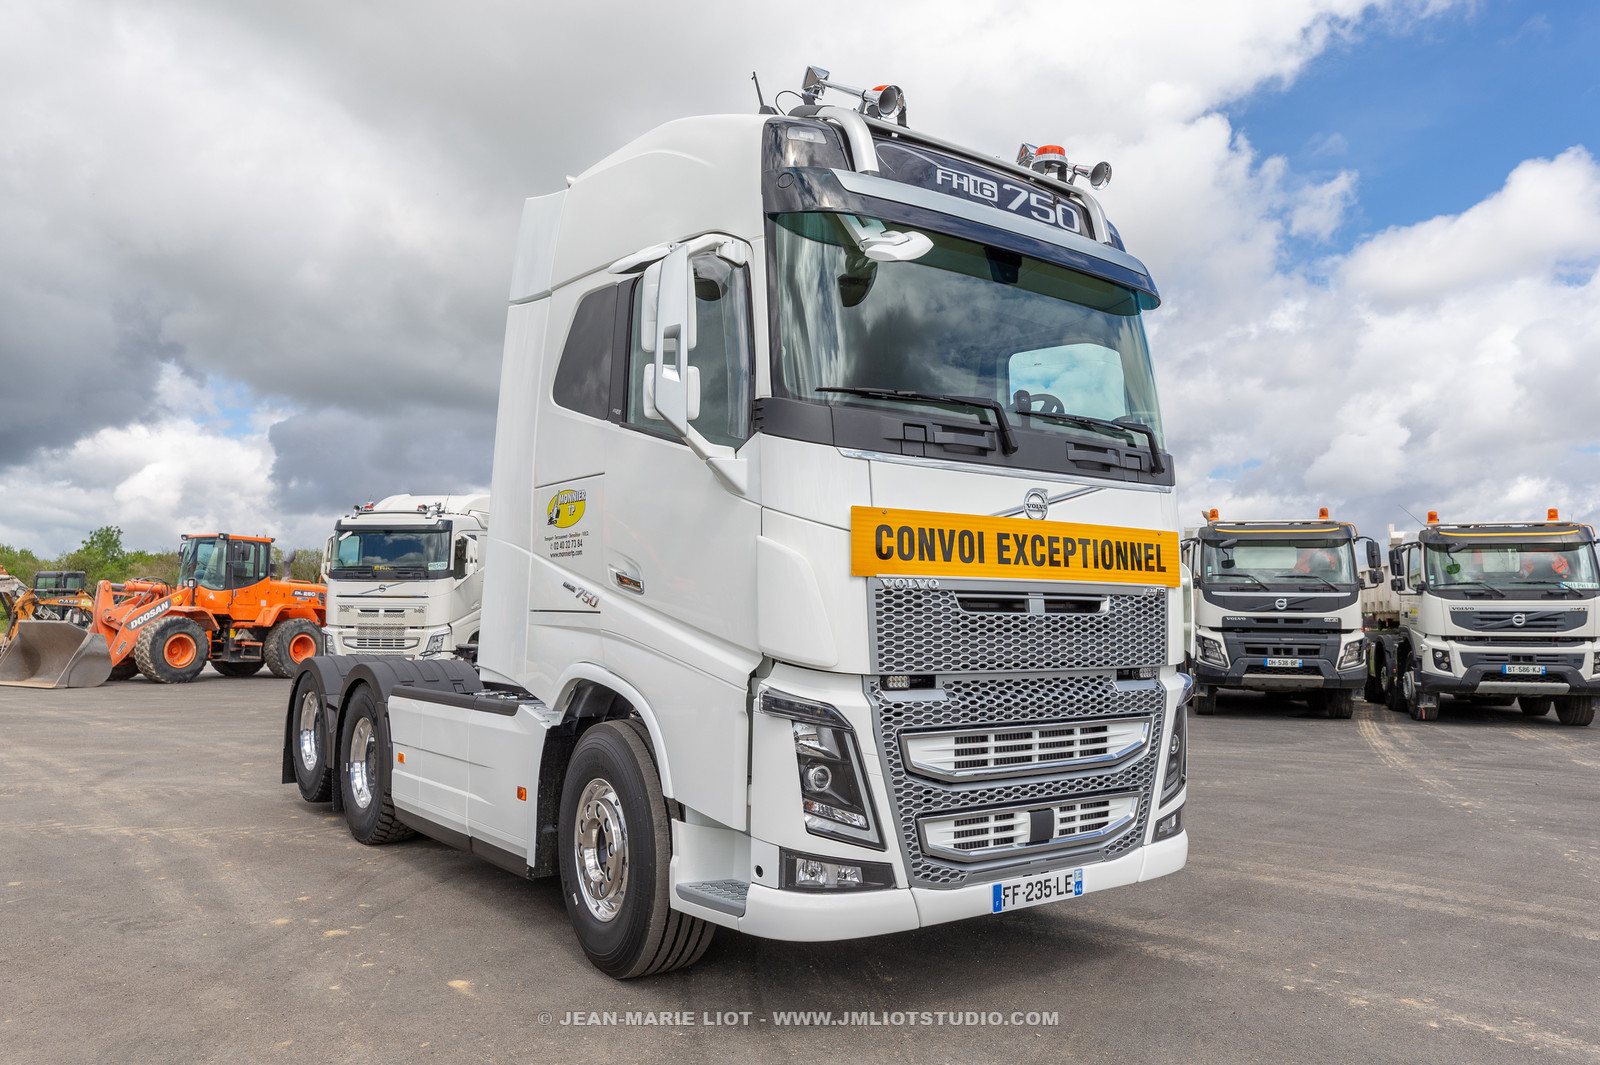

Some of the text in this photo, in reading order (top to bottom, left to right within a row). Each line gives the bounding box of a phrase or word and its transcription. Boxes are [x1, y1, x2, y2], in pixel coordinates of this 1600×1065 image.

[936, 168, 1081, 233] FH16 750
[559, 489, 587, 505] MONNIER
[875, 524, 1167, 573] CONVOI EXCEPTIONNEL
[880, 578, 940, 590] VOLVO
[575, 587, 600, 608] 750
[130, 601, 169, 629] DOOSAN
